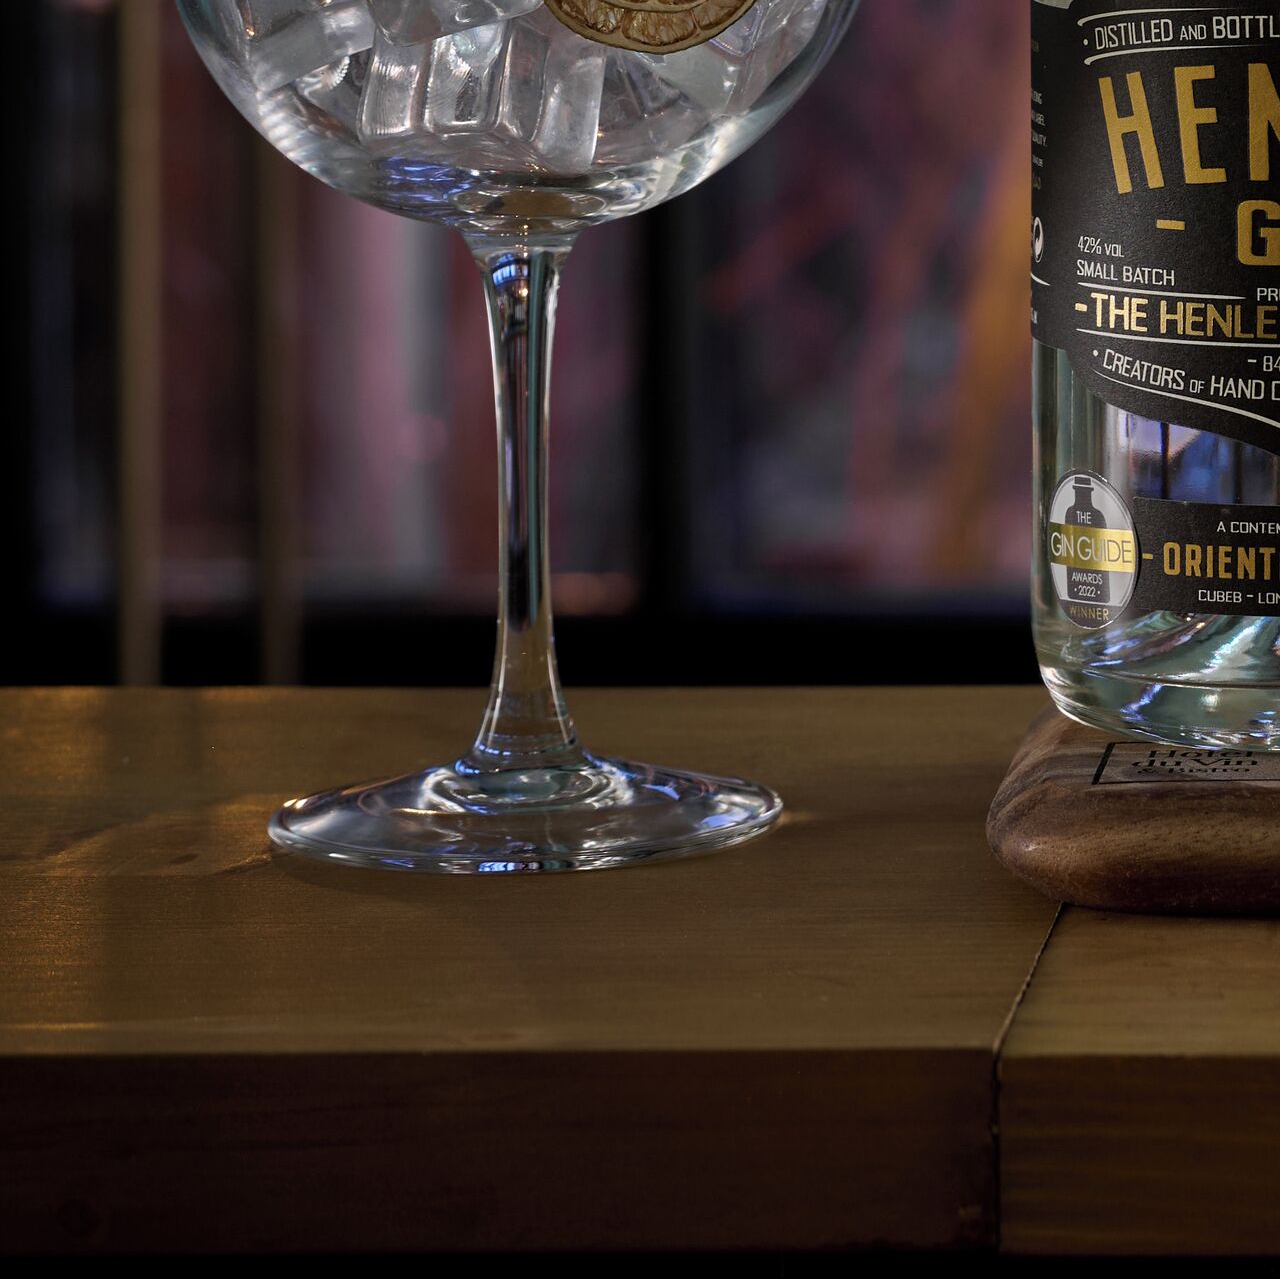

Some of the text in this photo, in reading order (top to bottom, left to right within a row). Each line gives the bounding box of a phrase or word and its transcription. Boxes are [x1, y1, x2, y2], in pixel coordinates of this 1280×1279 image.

[1095, 19, 1173, 50] DISTILLED
[1179, 24, 1206, 41] AND
[1078, 236, 1125, 258] 42% VOL
[1077, 260, 1175, 286] SMALL BATCH
[1090, 292, 1149, 331] THE
[1102, 348, 1185, 391] CREATORS
[1209, 374, 1265, 401] HAND
[1076, 510, 1092, 524] THE
[1050, 532, 1132, 564] GIN GUIDE
[1071, 572, 1102, 585] AWARDS
[1078, 586, 1097, 597] 2022
[1198, 590, 1242, 604] CUBEB
[1069, 606, 1109, 621] WINNER
